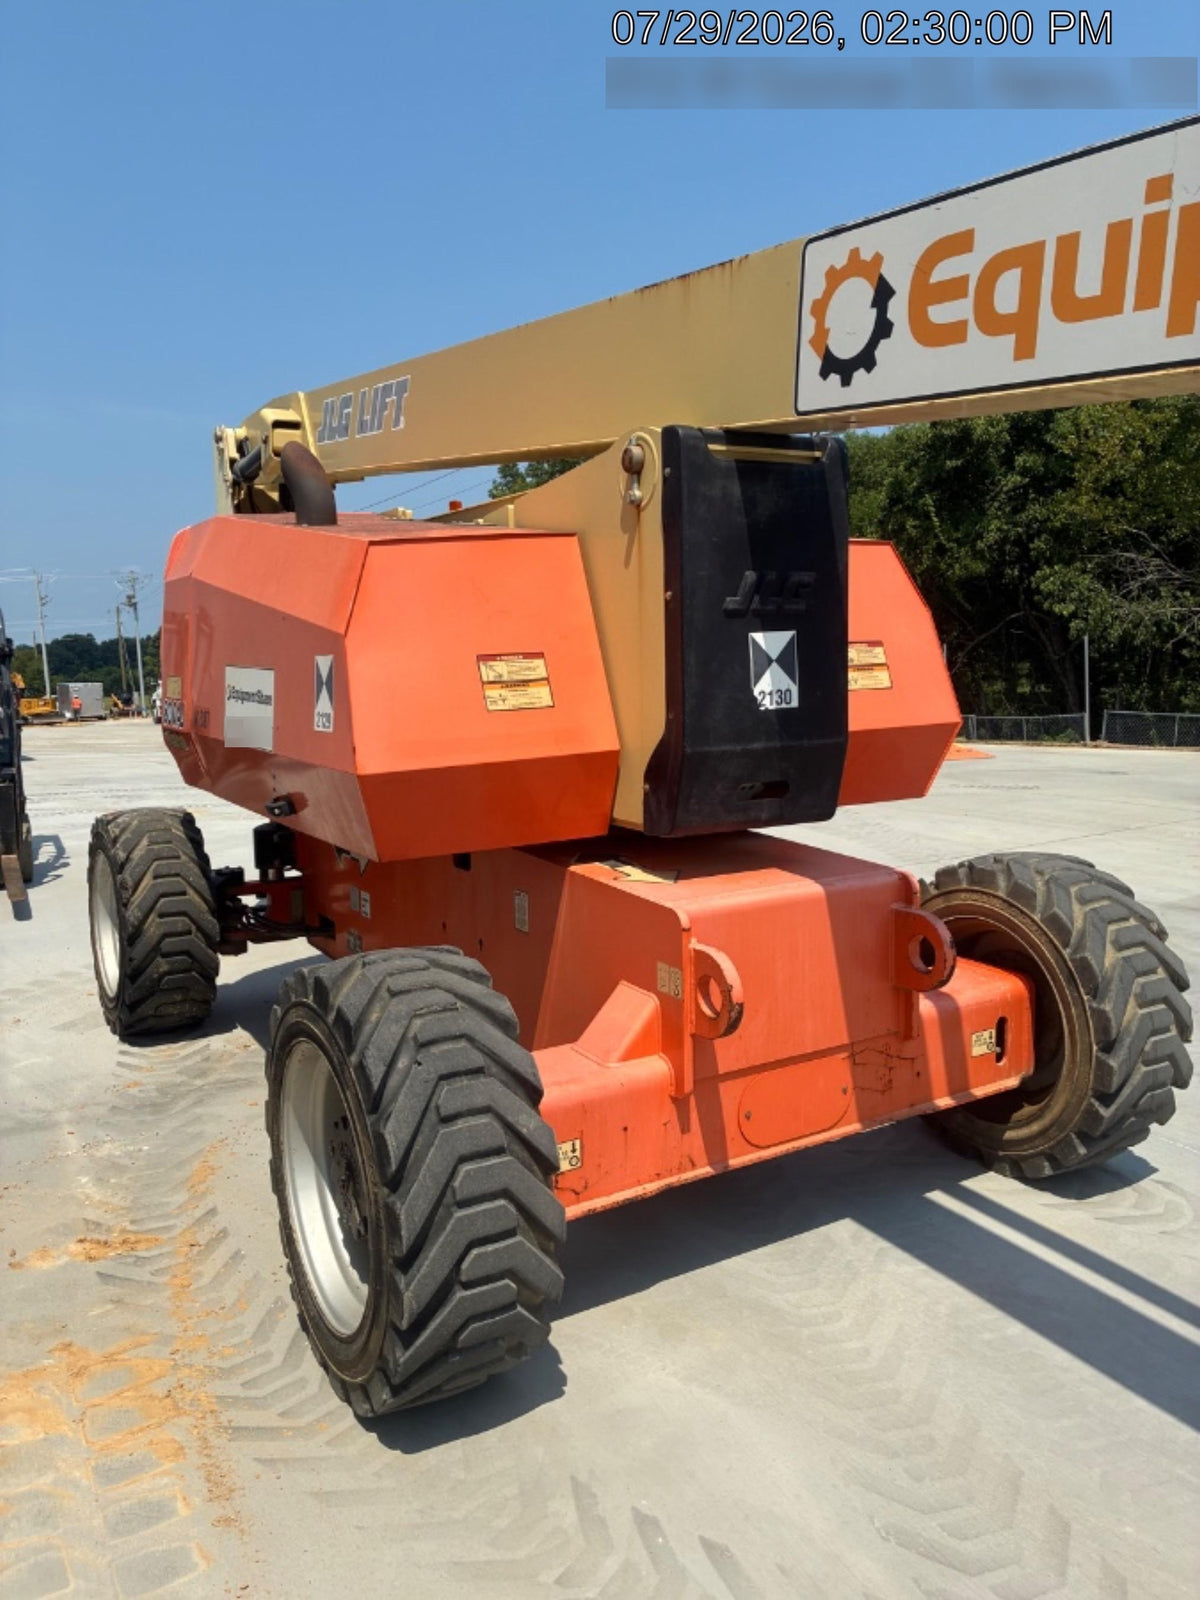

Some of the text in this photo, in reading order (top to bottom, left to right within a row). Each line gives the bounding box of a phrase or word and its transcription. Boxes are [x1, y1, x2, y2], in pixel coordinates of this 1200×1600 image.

[317, 375, 411, 445] JLG LIFT
[758, 688, 792, 707] 2130
